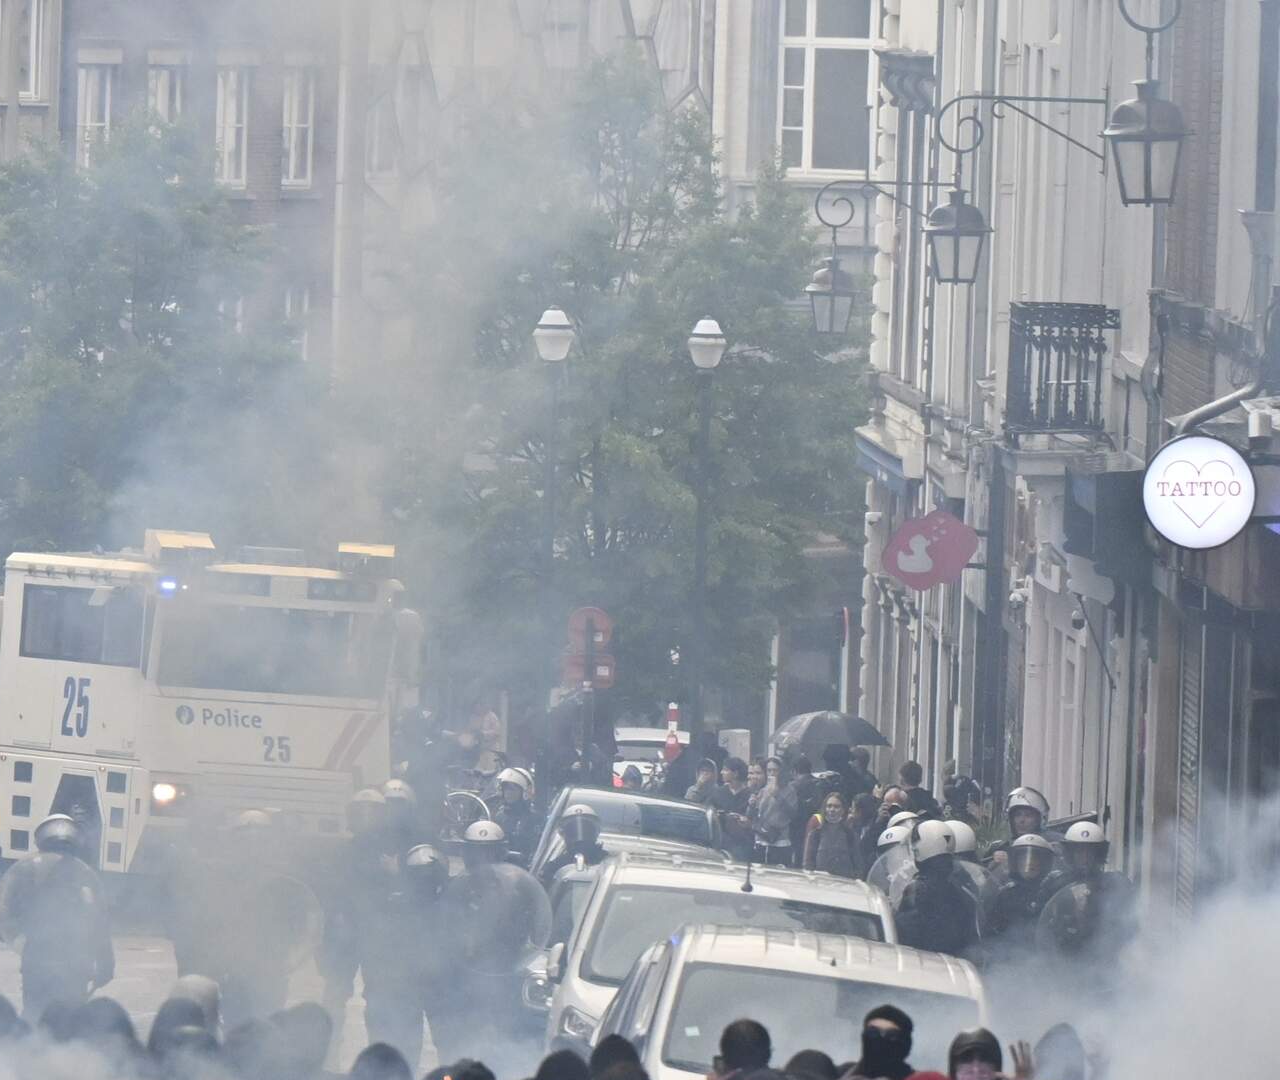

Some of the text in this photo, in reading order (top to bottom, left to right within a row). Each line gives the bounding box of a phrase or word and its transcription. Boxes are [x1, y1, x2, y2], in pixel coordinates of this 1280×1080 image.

[1157, 481, 1242, 496] TATTOO
[61, 676, 91, 738] 25
[202, 708, 262, 728] Police
[263, 736, 291, 762] 25
